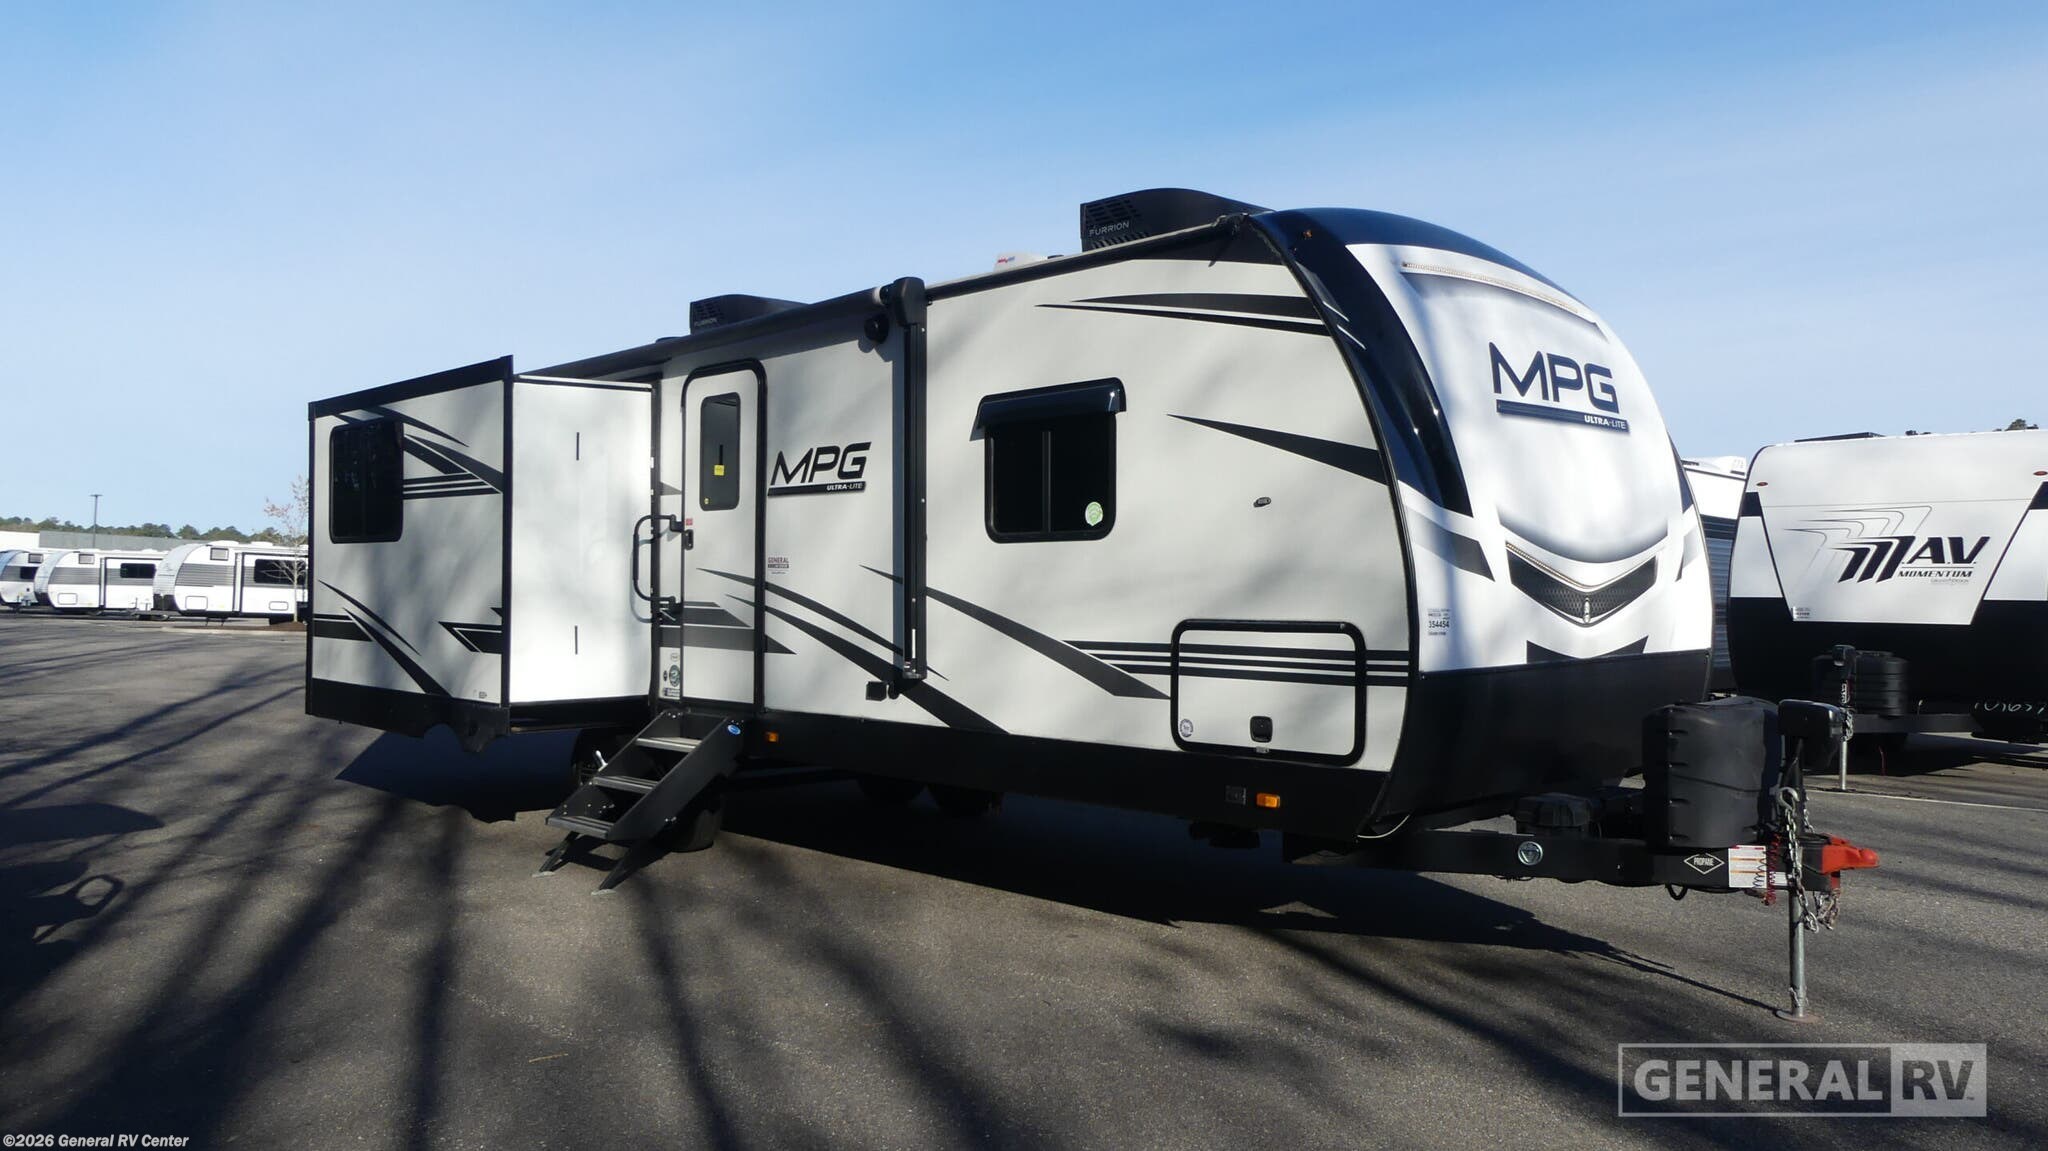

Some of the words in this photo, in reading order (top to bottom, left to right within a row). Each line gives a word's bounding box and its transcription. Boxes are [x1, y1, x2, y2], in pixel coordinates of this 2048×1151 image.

[1089, 220, 1129, 237] FURRION
[1489, 342, 1620, 414] MPG
[1584, 414, 1627, 429] ULTRA-LITE
[770, 441, 872, 486] MPG
[826, 483, 863, 491] ULTRA-LITE
[1897, 570, 1973, 578] MOMENTUM
[1693, 857, 1715, 866] PROPANE
